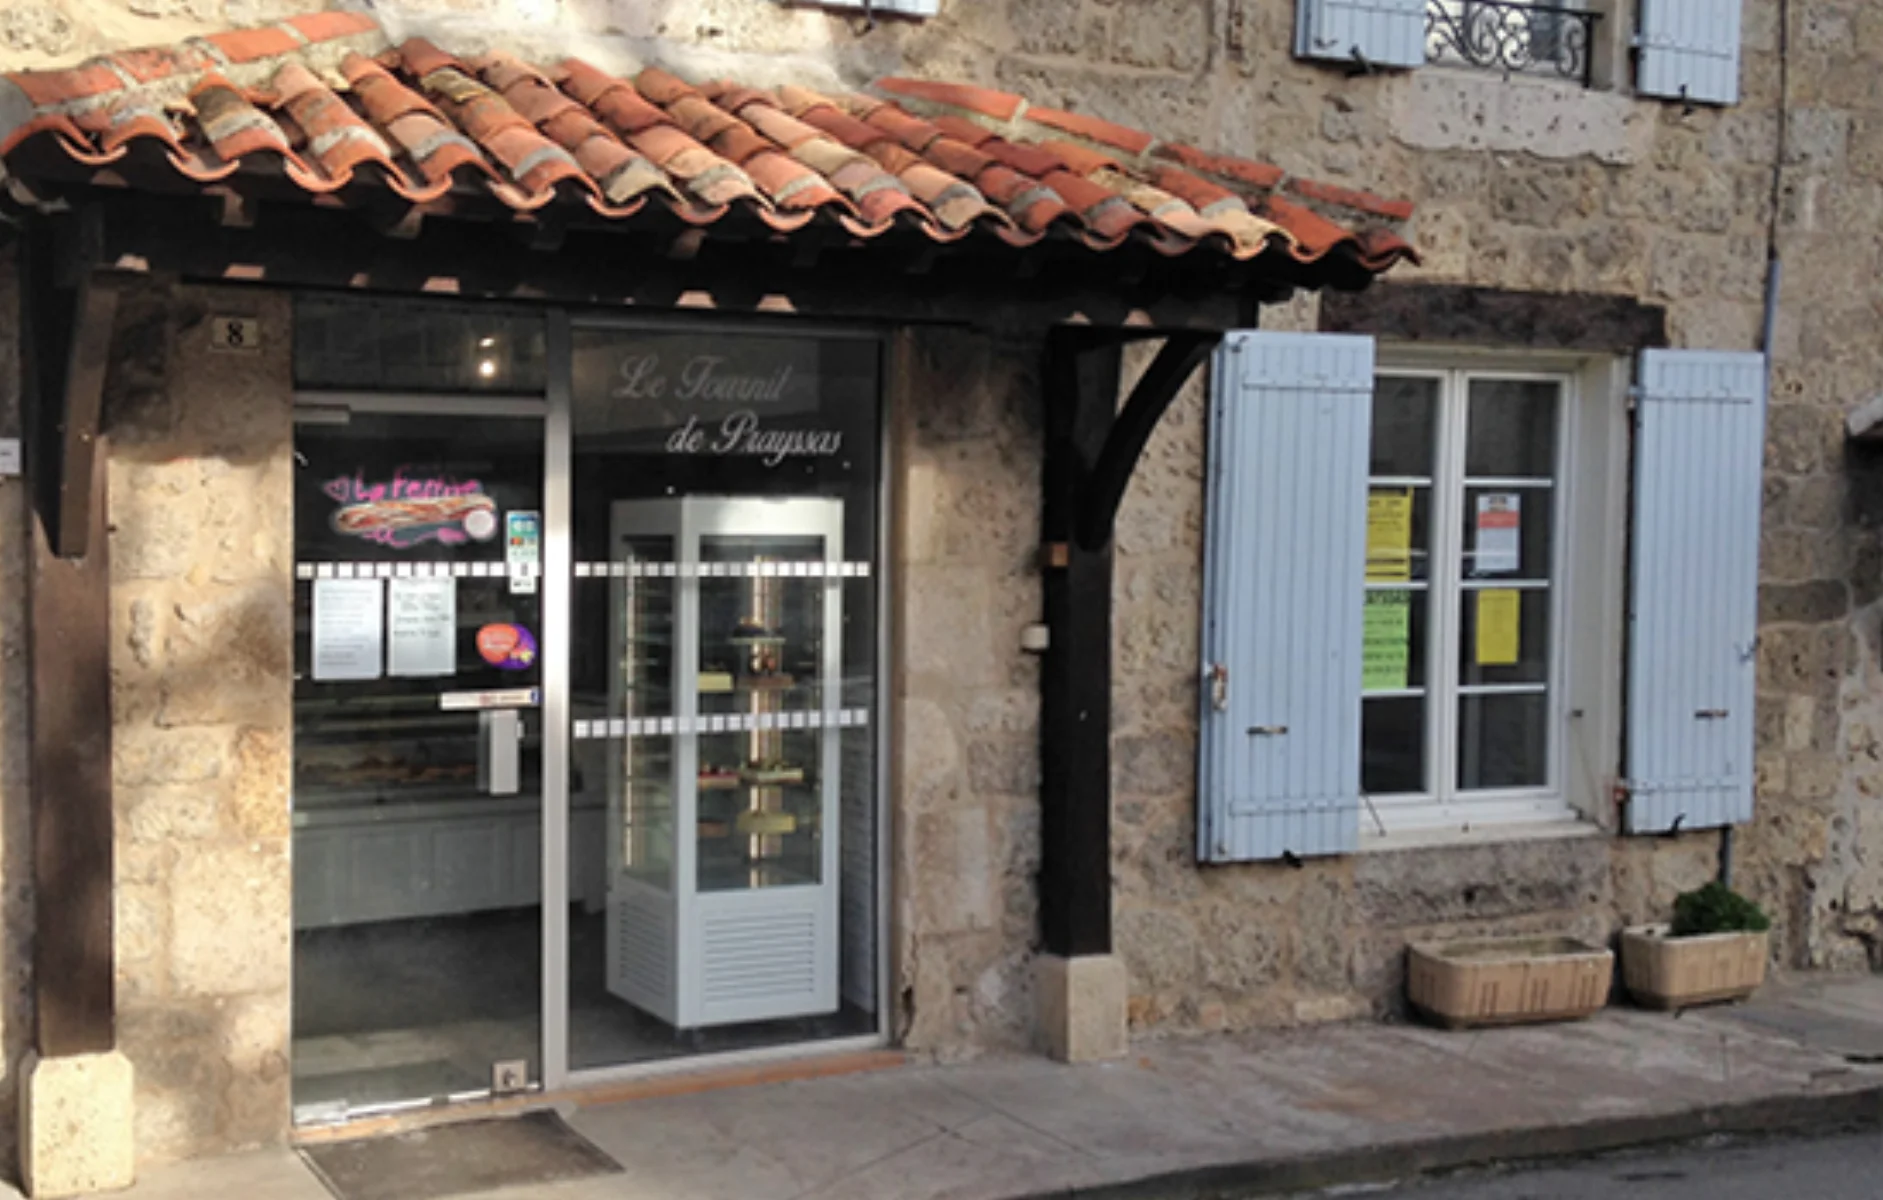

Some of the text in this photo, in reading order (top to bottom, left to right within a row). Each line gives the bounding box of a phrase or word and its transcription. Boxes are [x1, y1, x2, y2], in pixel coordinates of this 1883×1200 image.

[228, 320, 244, 348] 8
[613, 353, 667, 399] Le
[666, 409, 843, 467] de Prayssas
